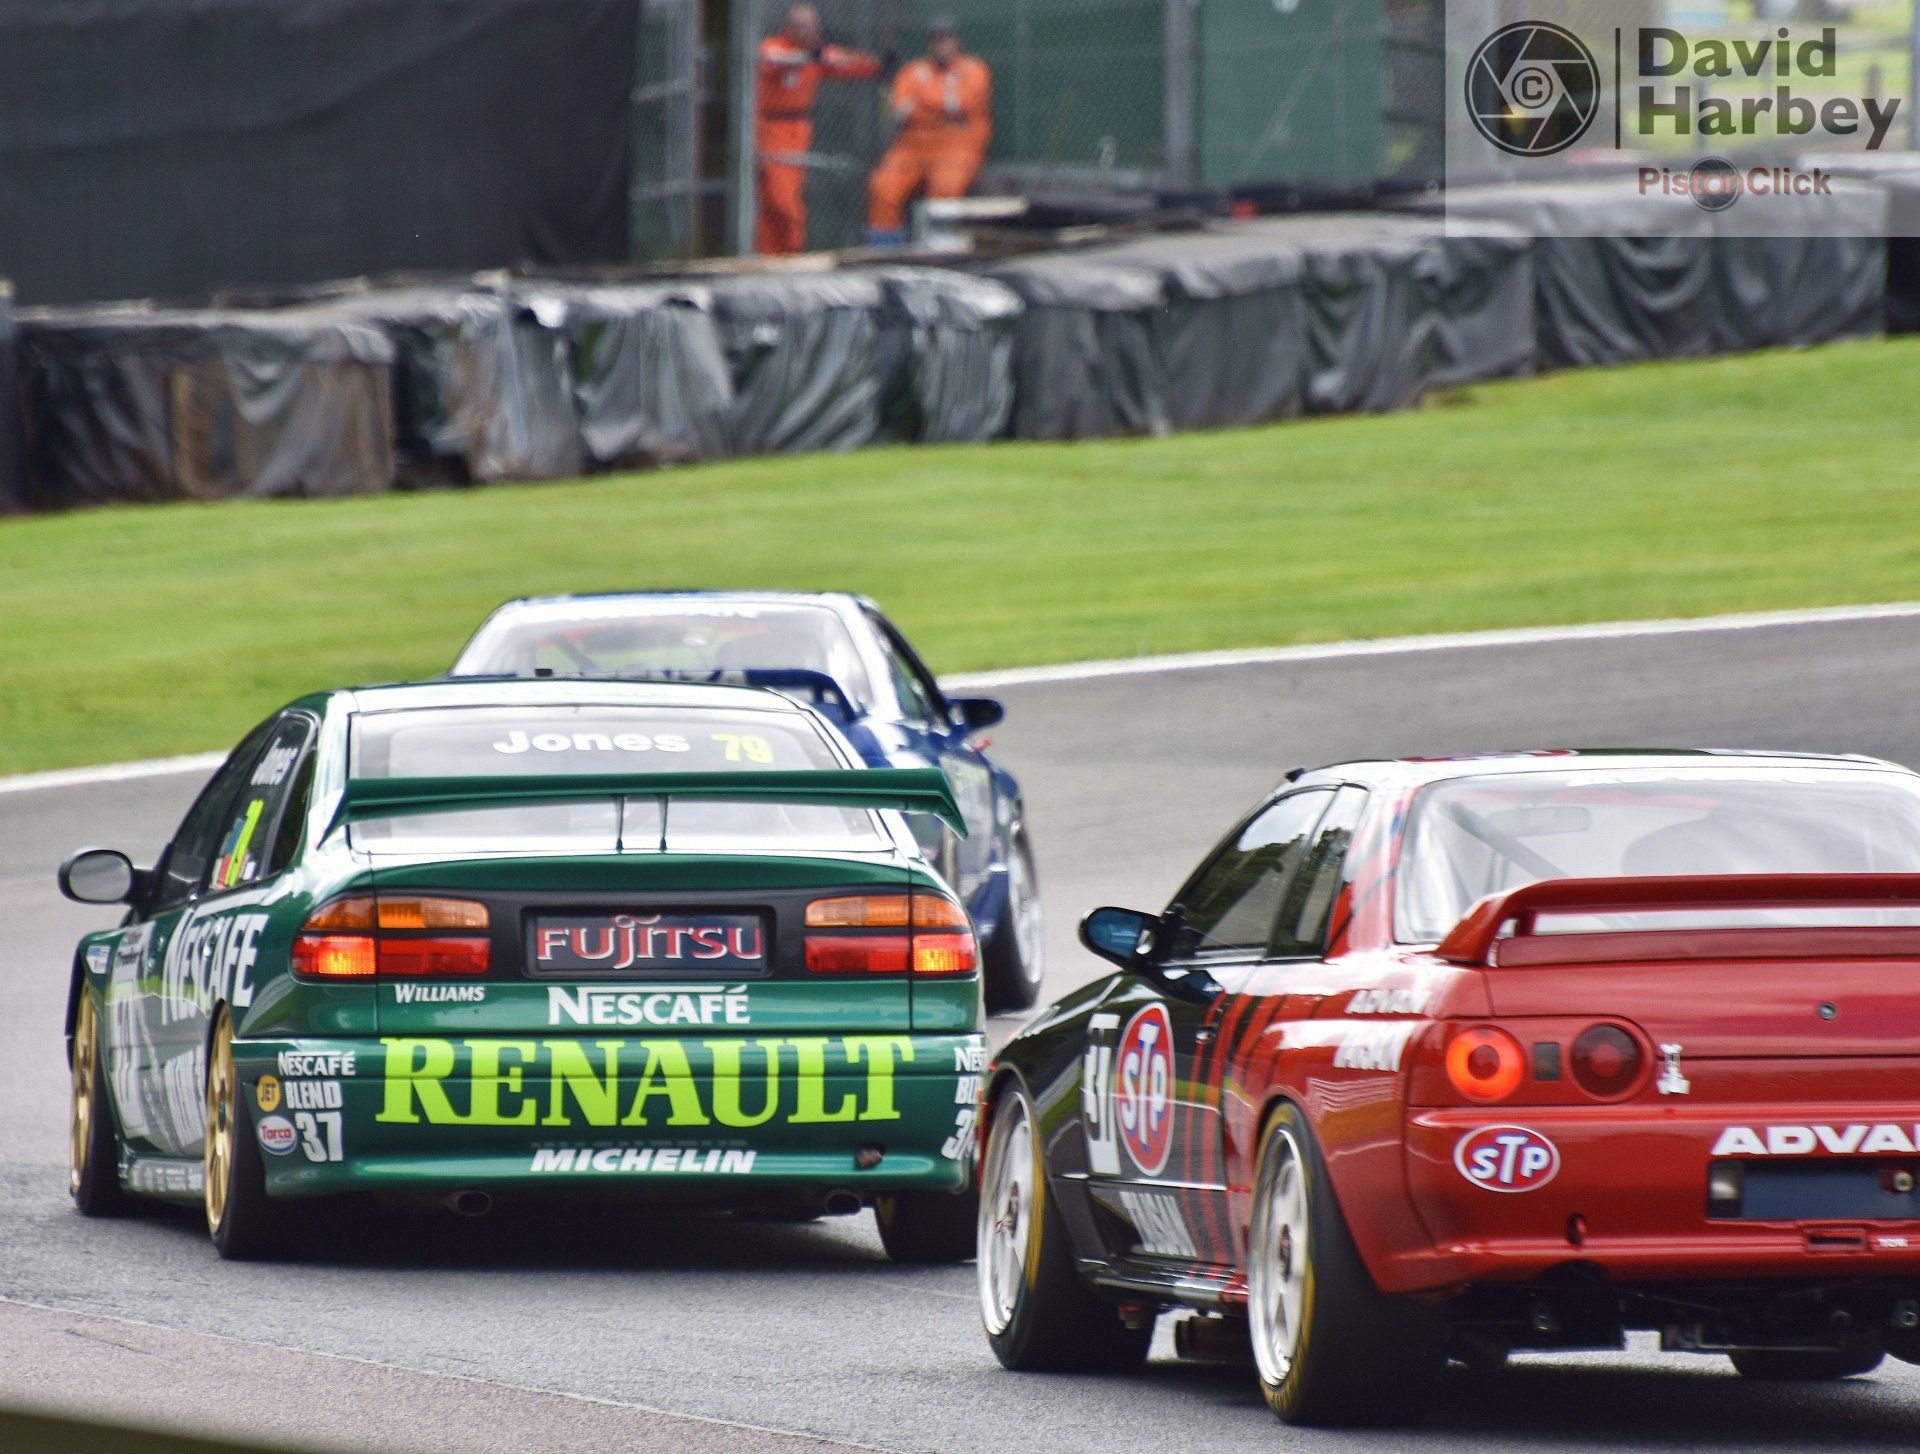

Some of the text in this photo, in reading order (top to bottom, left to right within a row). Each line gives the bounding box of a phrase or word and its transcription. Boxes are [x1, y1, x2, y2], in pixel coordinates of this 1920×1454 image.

[492, 730, 774, 764] Jones 79
[537, 914, 763, 970] FUJITSU
[394, 983, 486, 1004] WILLIAMS
[547, 984, 752, 1026] NESCAFÉ
[278, 1050, 357, 1077] NESCAFÉ
[375, 1034, 915, 1128] RENAULT
[284, 1080, 344, 1110] BLEND
[1121, 1022, 1168, 1149] STP
[294, 1111, 344, 1163] 37
[1711, 1123, 1920, 1156] ADVA
[530, 1147, 757, 1174] MICHELIN
[1470, 1134, 1550, 1184] STP
